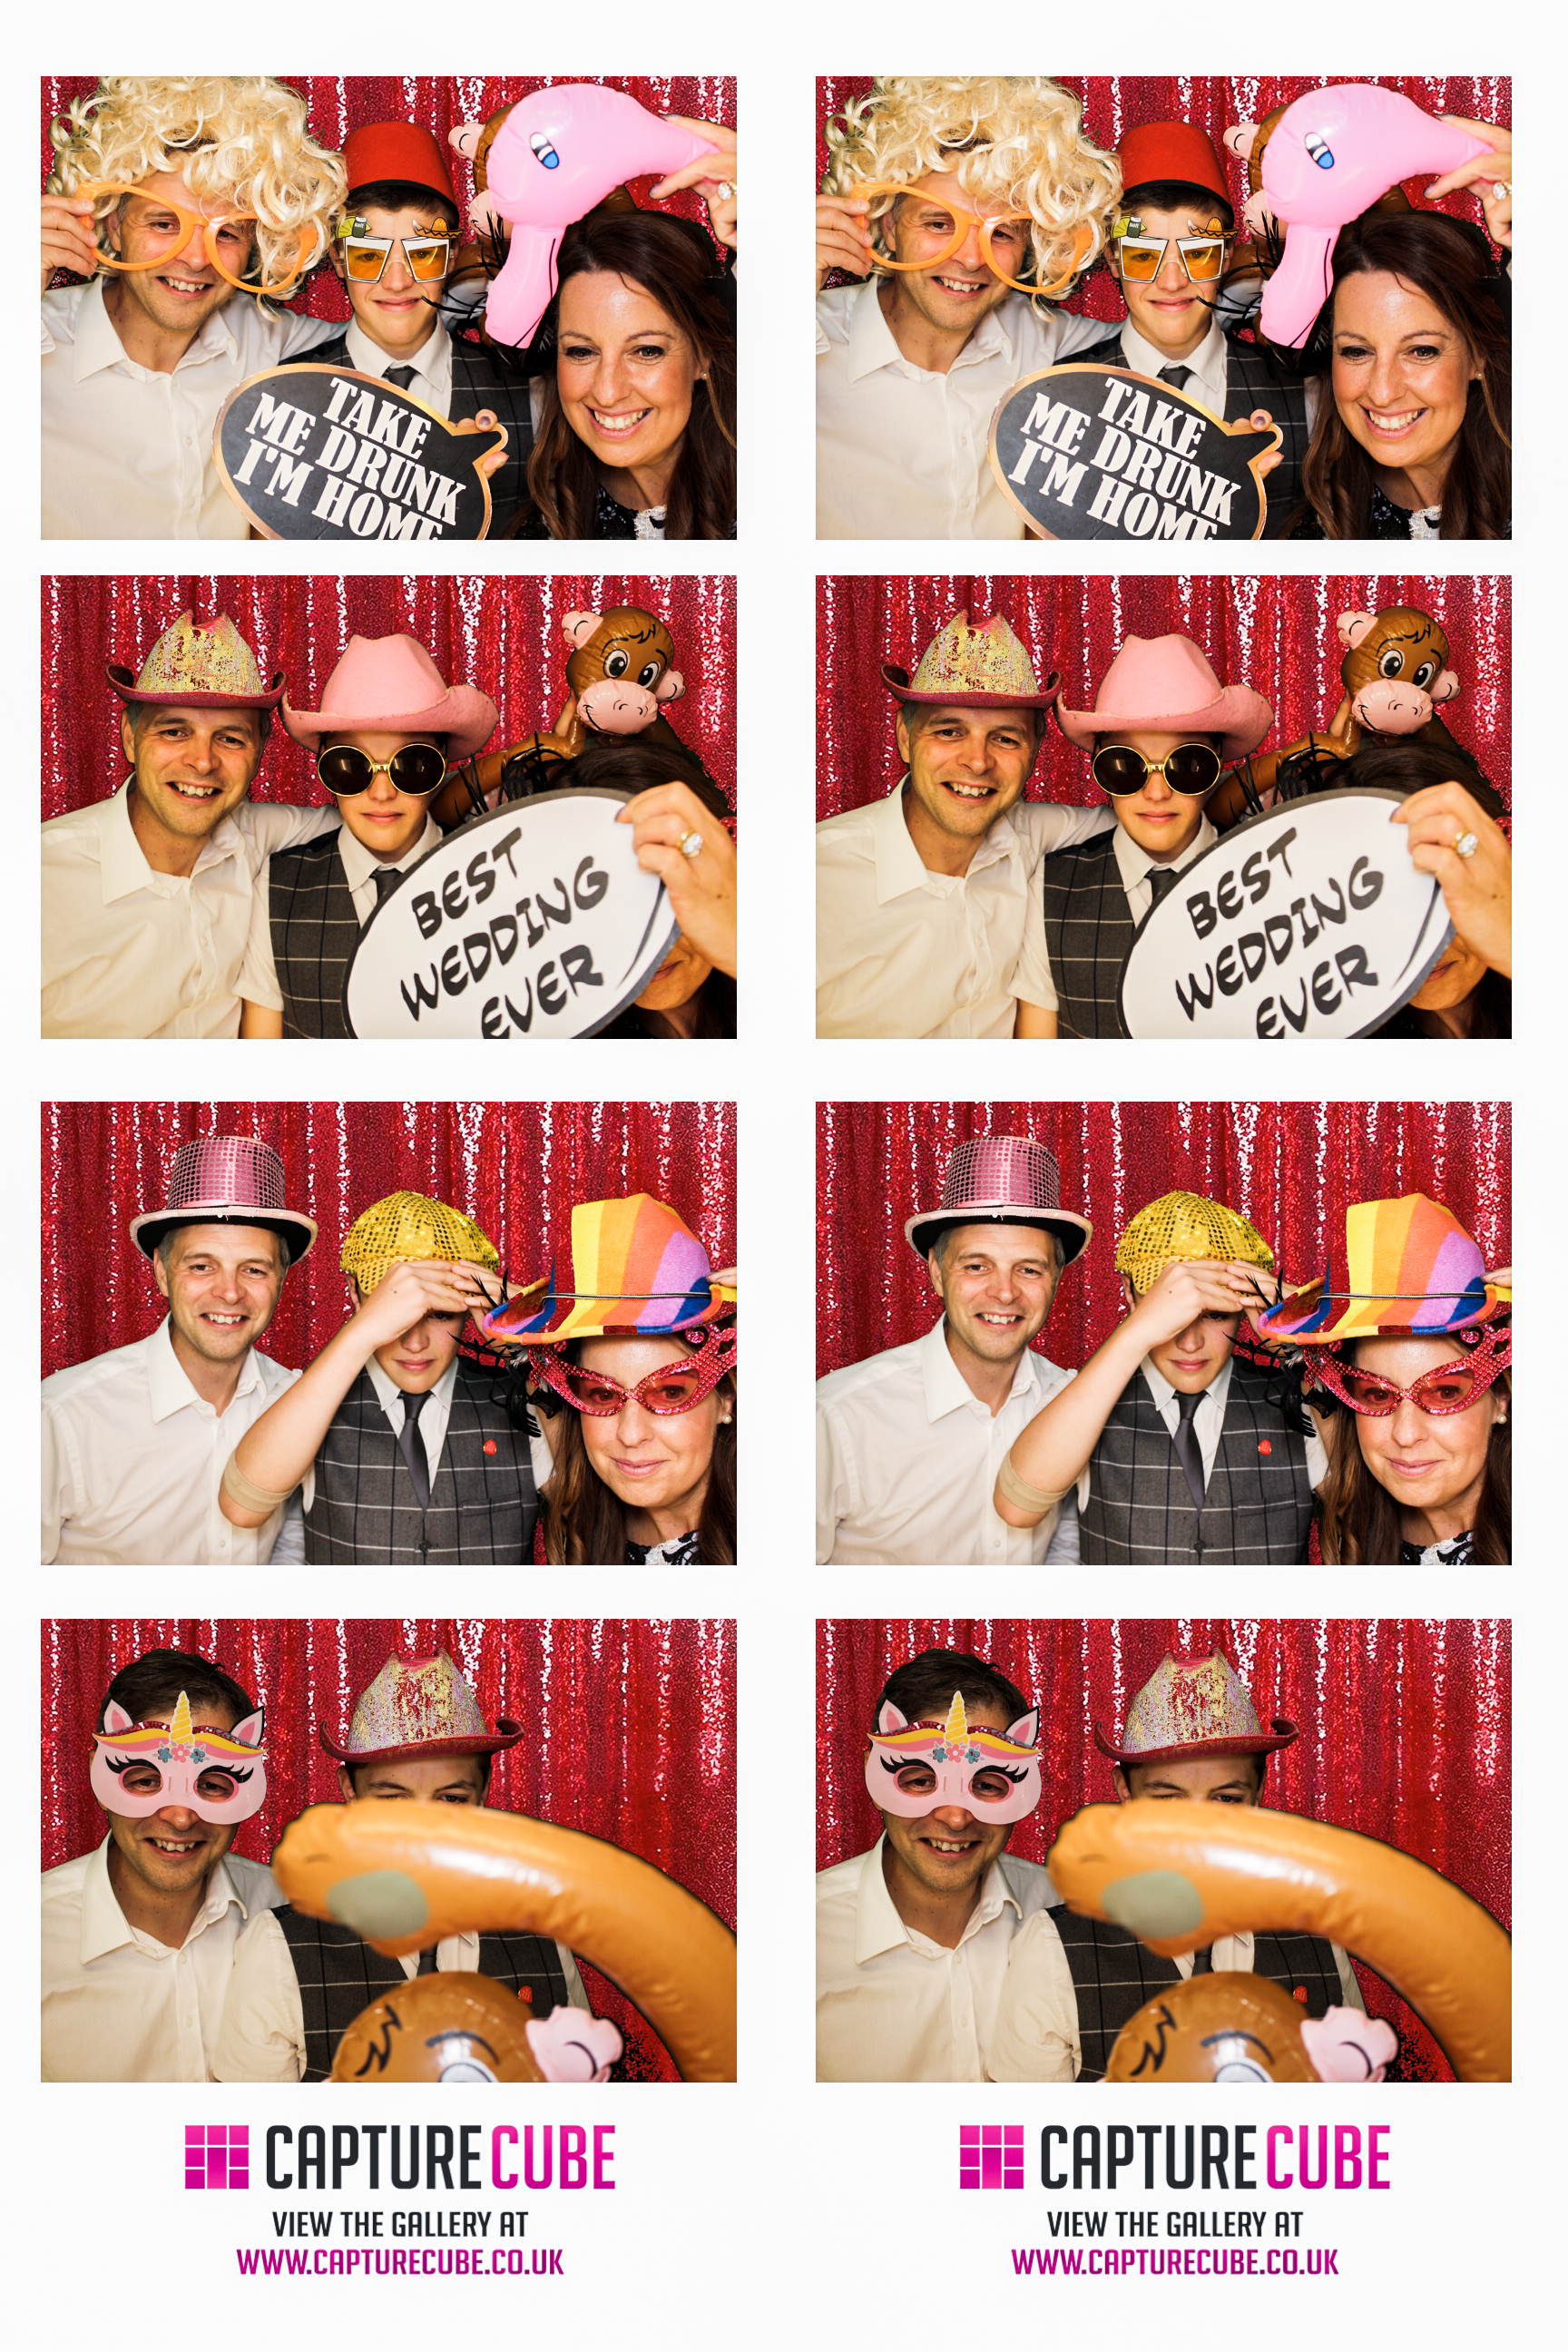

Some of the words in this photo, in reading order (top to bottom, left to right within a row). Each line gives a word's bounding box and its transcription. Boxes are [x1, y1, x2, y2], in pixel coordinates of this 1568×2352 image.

[245, 392, 316, 456] ME
[315, 425, 466, 525] DRUNK
[323, 377, 431, 459] TAKE
[1020, 392, 1091, 456] ME
[1090, 425, 1241, 525] DRUNK
[1098, 377, 1206, 459] TAKE
[233, 438, 314, 506] I'M
[1008, 438, 1089, 506] I'M
[411, 828, 522, 940] BEST
[1186, 828, 1297, 940] BEST
[401, 856, 609, 1022] WEDDING
[1176, 856, 1384, 1022] WEDDING
[482, 945, 603, 1039] EVER
[1257, 945, 1378, 1039] EVER
